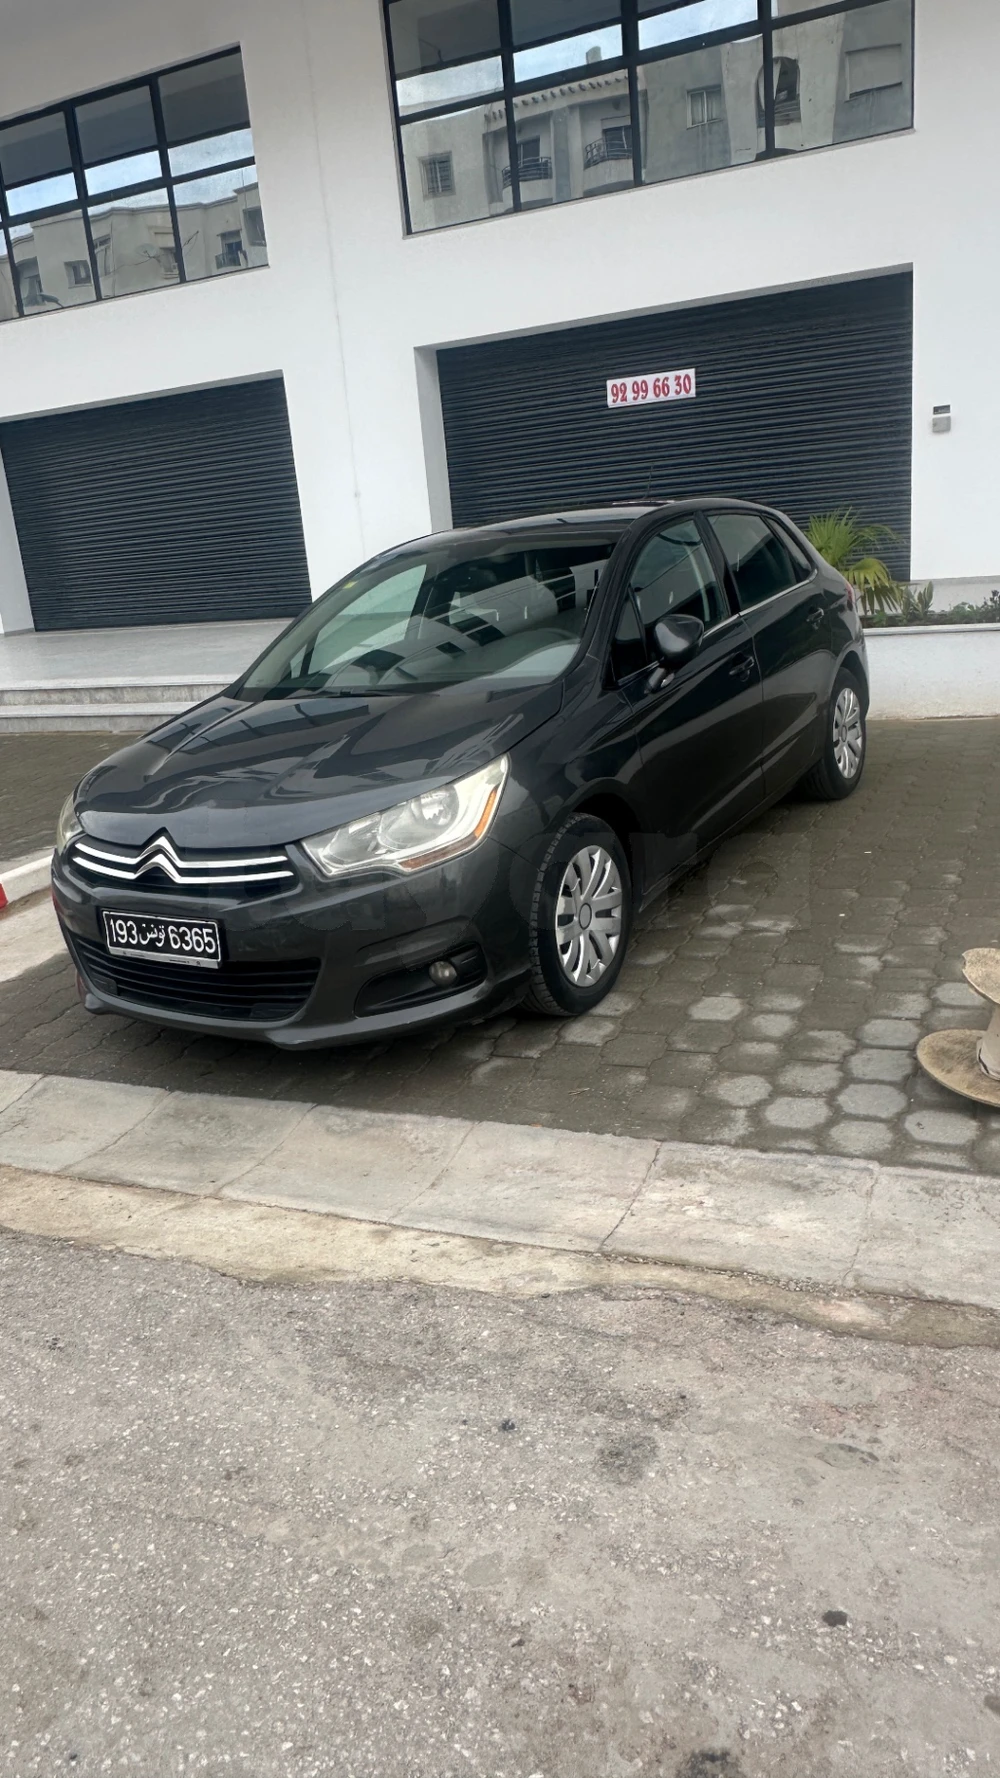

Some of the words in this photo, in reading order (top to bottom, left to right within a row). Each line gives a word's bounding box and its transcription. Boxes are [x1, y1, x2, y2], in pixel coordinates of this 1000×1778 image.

[611, 383, 627, 403] 92
[631, 380, 648, 401] 99
[652, 377, 670, 397] 66
[674, 373, 692, 395] 30
[110, 918, 138, 945] 193
[139, 923, 166, 947] تونس
[167, 925, 216, 954] 6365
